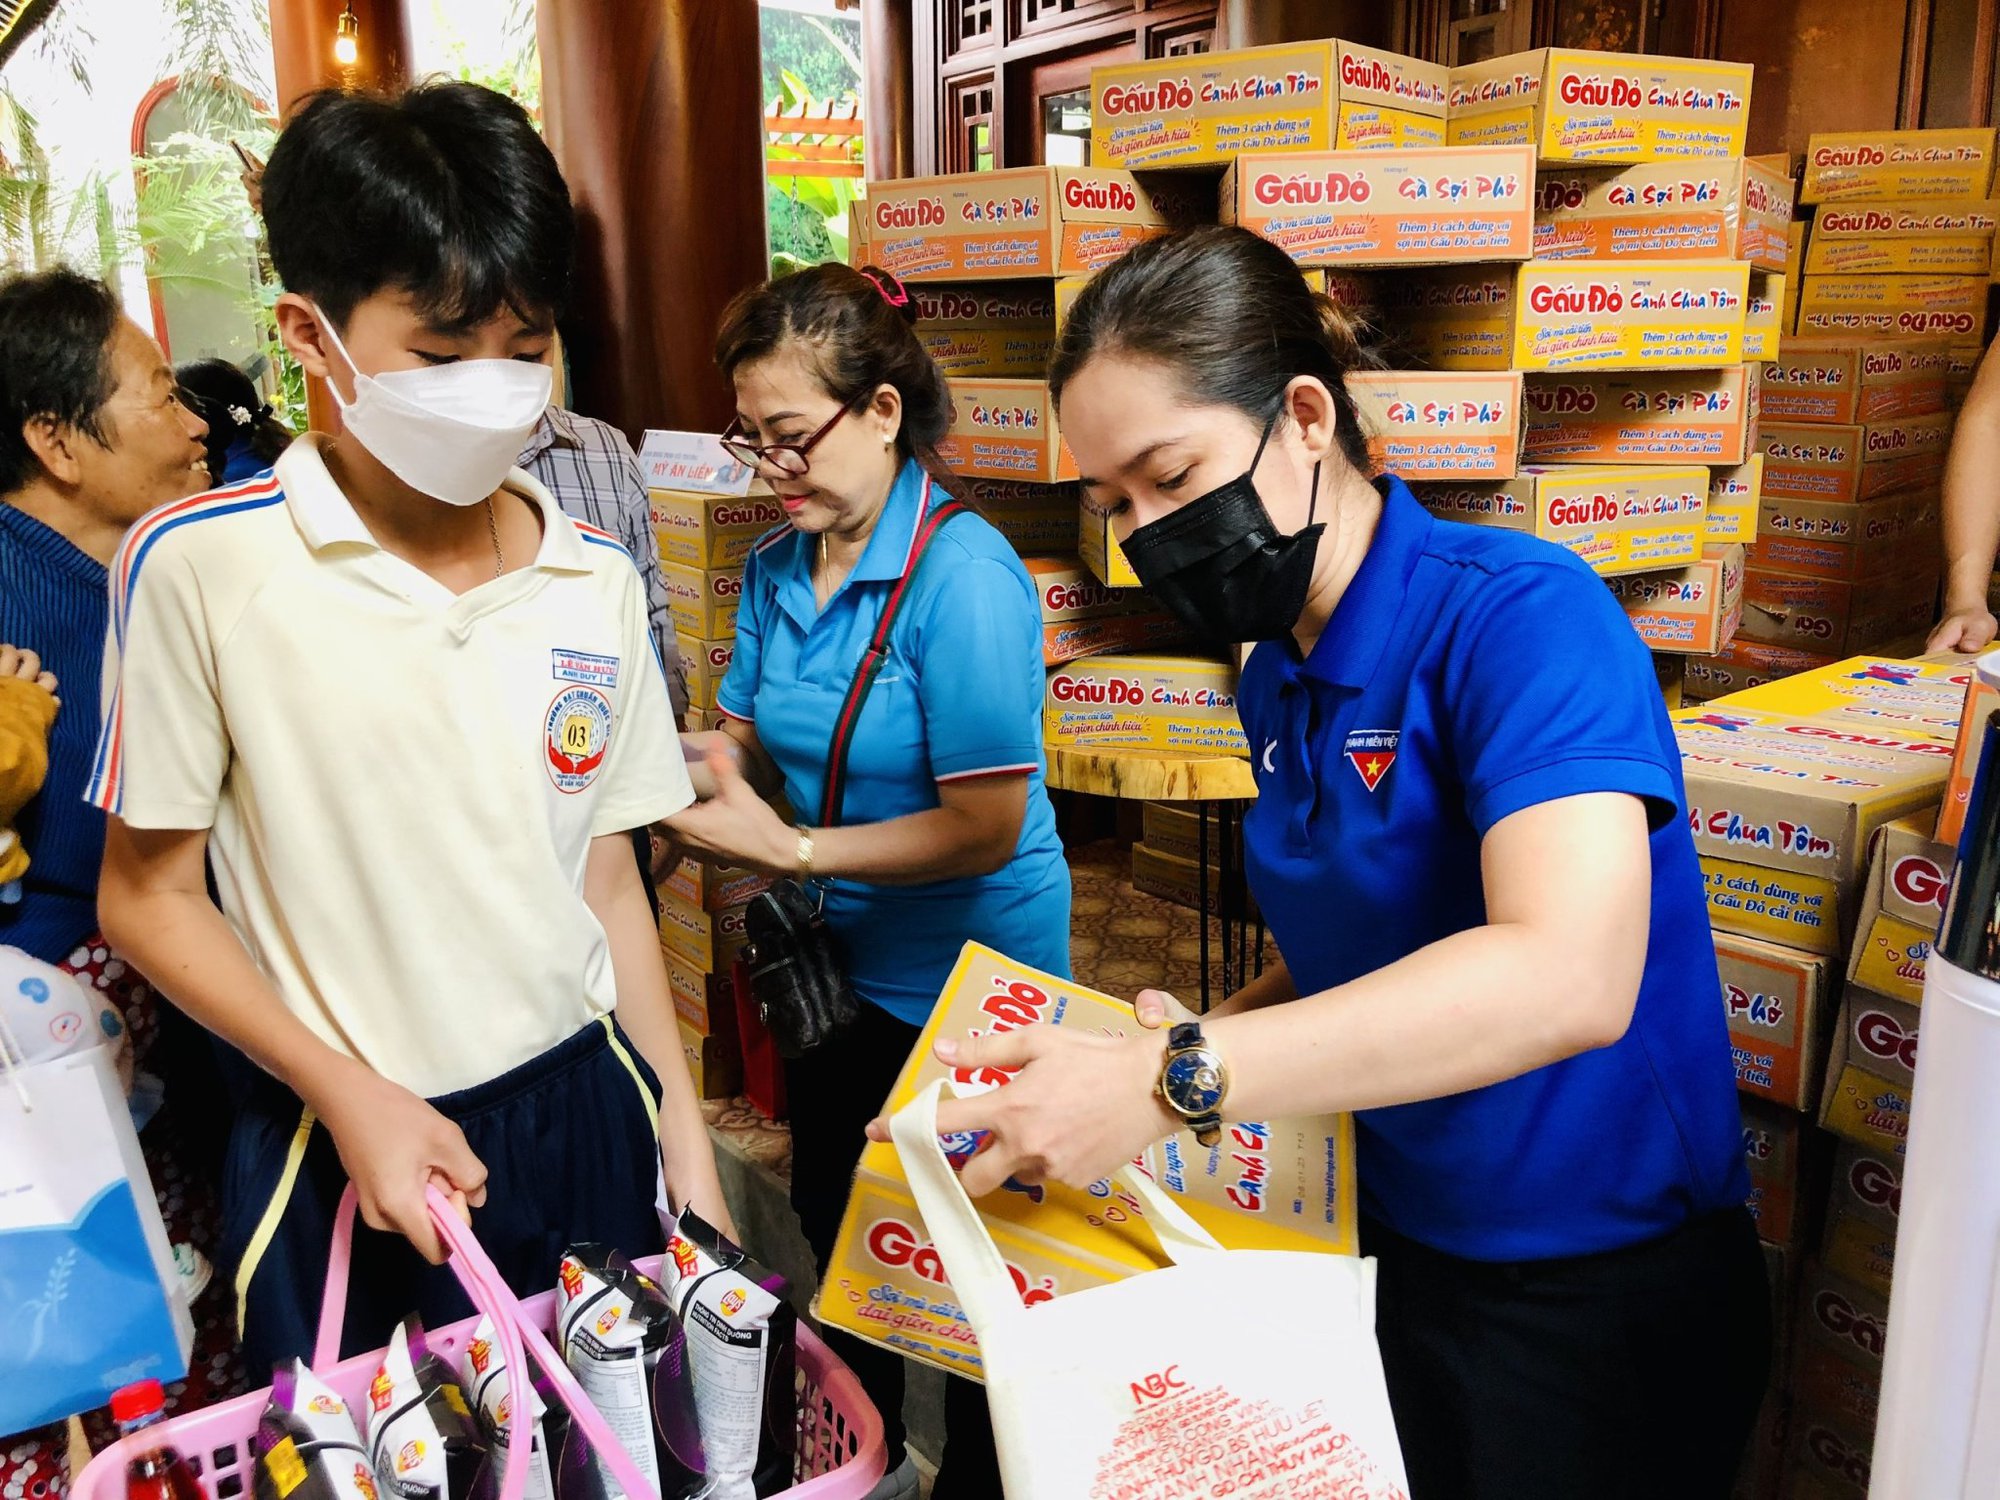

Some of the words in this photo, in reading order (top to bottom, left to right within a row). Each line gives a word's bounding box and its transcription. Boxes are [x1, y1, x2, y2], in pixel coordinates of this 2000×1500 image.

[1201, 83, 1238, 103] Canh
[1243, 79, 1282, 99] Chua
[1287, 72, 1319, 93] Tôm
[1648, 88, 1679, 107] Canh
[1683, 90, 1713, 109] Chua
[1717, 92, 1741, 109] Tôm
[1216, 124, 1240, 136] Thêm
[1243, 124, 1248, 133] 3
[1250, 122, 1271, 133] cách
[1273, 121, 1296, 134] dùng
[1890, 150, 1919, 162] Canh
[1924, 150, 1953, 162] Chua
[1957, 148, 1981, 160] Tôm
[1399, 178, 1428, 200] Gà
[1435, 177, 1468, 203] Sợi
[1476, 176, 1518, 198] Phở
[1608, 184, 1635, 206] Gà
[1643, 182, 1672, 208] Sợi
[1680, 181, 1719, 203] Phở
[962, 201, 982, 221] Gà
[985, 200, 1008, 224] Sợi
[1012, 197, 1040, 219] Phở
[1308, 226, 1338, 239] chính
[1341, 223, 1366, 238] hiệu
[1397, 222, 1427, 233] Thêm
[1431, 222, 1437, 232] 3
[1440, 222, 1465, 232] cách
[1468, 221, 1494, 234] dùng
[1898, 216, 1929, 230] Canh
[1933, 216, 1965, 229] Chua
[1969, 215, 1994, 229] Tôm
[1490, 234, 1510, 245] tiến
[1630, 292, 1666, 310] Canh
[1671, 291, 1706, 309] Chua
[1710, 290, 1738, 308] Tôm
[1572, 334, 1597, 348] chính
[1765, 367, 1784, 382] Gà
[1789, 368, 1810, 385] Sợi
[1815, 366, 1843, 383] Phở
[1621, 392, 1648, 412] Gà
[1655, 392, 1686, 415] Sợi
[1692, 391, 1730, 412] Phở
[972, 405, 989, 425] Gà
[992, 407, 1010, 430] Sợi
[1014, 407, 1039, 428] Phở
[1387, 402, 1415, 423] Gà
[1424, 402, 1454, 427] Sợi
[1463, 401, 1503, 423] Phở
[1386, 445, 1414, 455] Thêm
[1418, 446, 1424, 454] 3
[1427, 445, 1451, 454] cách
[1455, 445, 1480, 456] dùng
[1719, 480, 1748, 494] Tôm
[1456, 493, 1491, 511] Chua
[1495, 495, 1524, 514] Tôm
[1623, 500, 1650, 517] Canh
[1653, 496, 1679, 514] Chua
[1682, 495, 1701, 512] Tôm
[1152, 688, 1190, 706] Canh
[1195, 691, 1235, 708] Chua
[568, 724, 586, 748] 03
[1096, 721, 1120, 731] chính
[1121, 721, 1142, 733] hiệu
[1707, 810, 1770, 845] Chua
[1778, 820, 1831, 854] Tôm
[1714, 873, 1723, 885] 3
[1727, 877, 1759, 893] cách
[1763, 882, 1799, 906] dùng
[1803, 894, 1824, 906] với
[1713, 892, 1741, 908] Gấu
[1745, 899, 1765, 914] Đỏ
[1768, 904, 1789, 920] cải
[1793, 909, 1821, 927] tiến
[1725, 983, 1783, 1026] Phở
[1755, 1053, 1774, 1069] với
[1744, 1070, 1772, 1088] tiến
[1226, 1153, 1267, 1211] Canh
[858, 1304, 892, 1320] dai
[938, 1324, 978, 1345] chín
